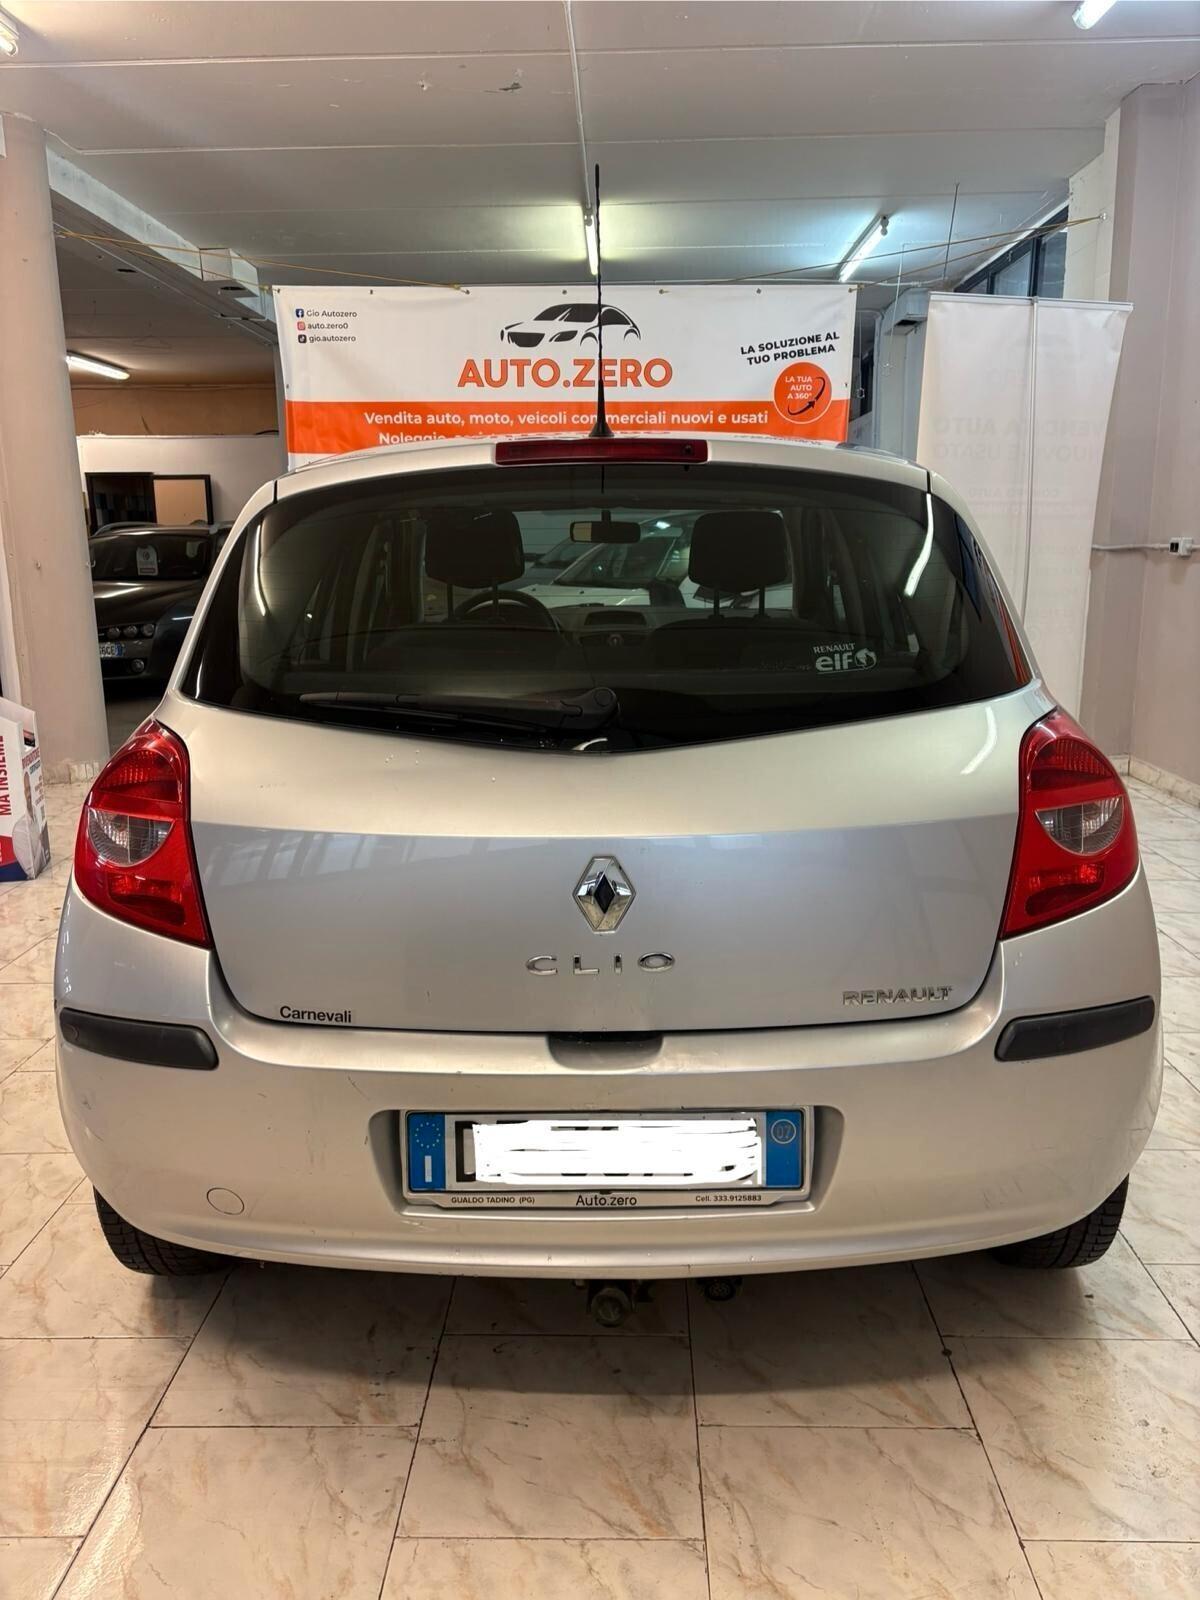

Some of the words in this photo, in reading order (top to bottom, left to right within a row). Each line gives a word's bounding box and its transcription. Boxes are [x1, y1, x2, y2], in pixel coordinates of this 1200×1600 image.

[321, 310, 358, 318] Autozero
[308, 334, 357, 343] gio.autozero
[740, 345, 756, 355] LA
[758, 333, 822, 352] SOLUZIONE
[825, 331, 841, 342] AL
[746, 354, 771, 366] TUO
[773, 343, 836, 361] PROBLEMA
[457, 358, 673, 388] AUTO.ZERO
[364, 411, 422, 425] Vendita
[426, 412, 465, 426] auto,
[469, 412, 514, 426] moto,
[518, 411, 567, 425] veicoli
[671, 411, 714, 424] nuovi
[718, 414, 727, 424] e
[731, 410, 769, 424] usati
[813, 642, 856, 654] RENAULT
[815, 652, 854, 672] elf
[525, 952, 676, 976] CLIO
[842, 986, 953, 1006] RENAULT
[279, 1005, 352, 1023] Carnevali
[451, 1196, 484, 1204] GUALDO
[486, 1196, 516, 1204] TADINO
[518, 1196, 536, 1205] (PG)
[575, 1194, 638, 1207] Auto.zero
